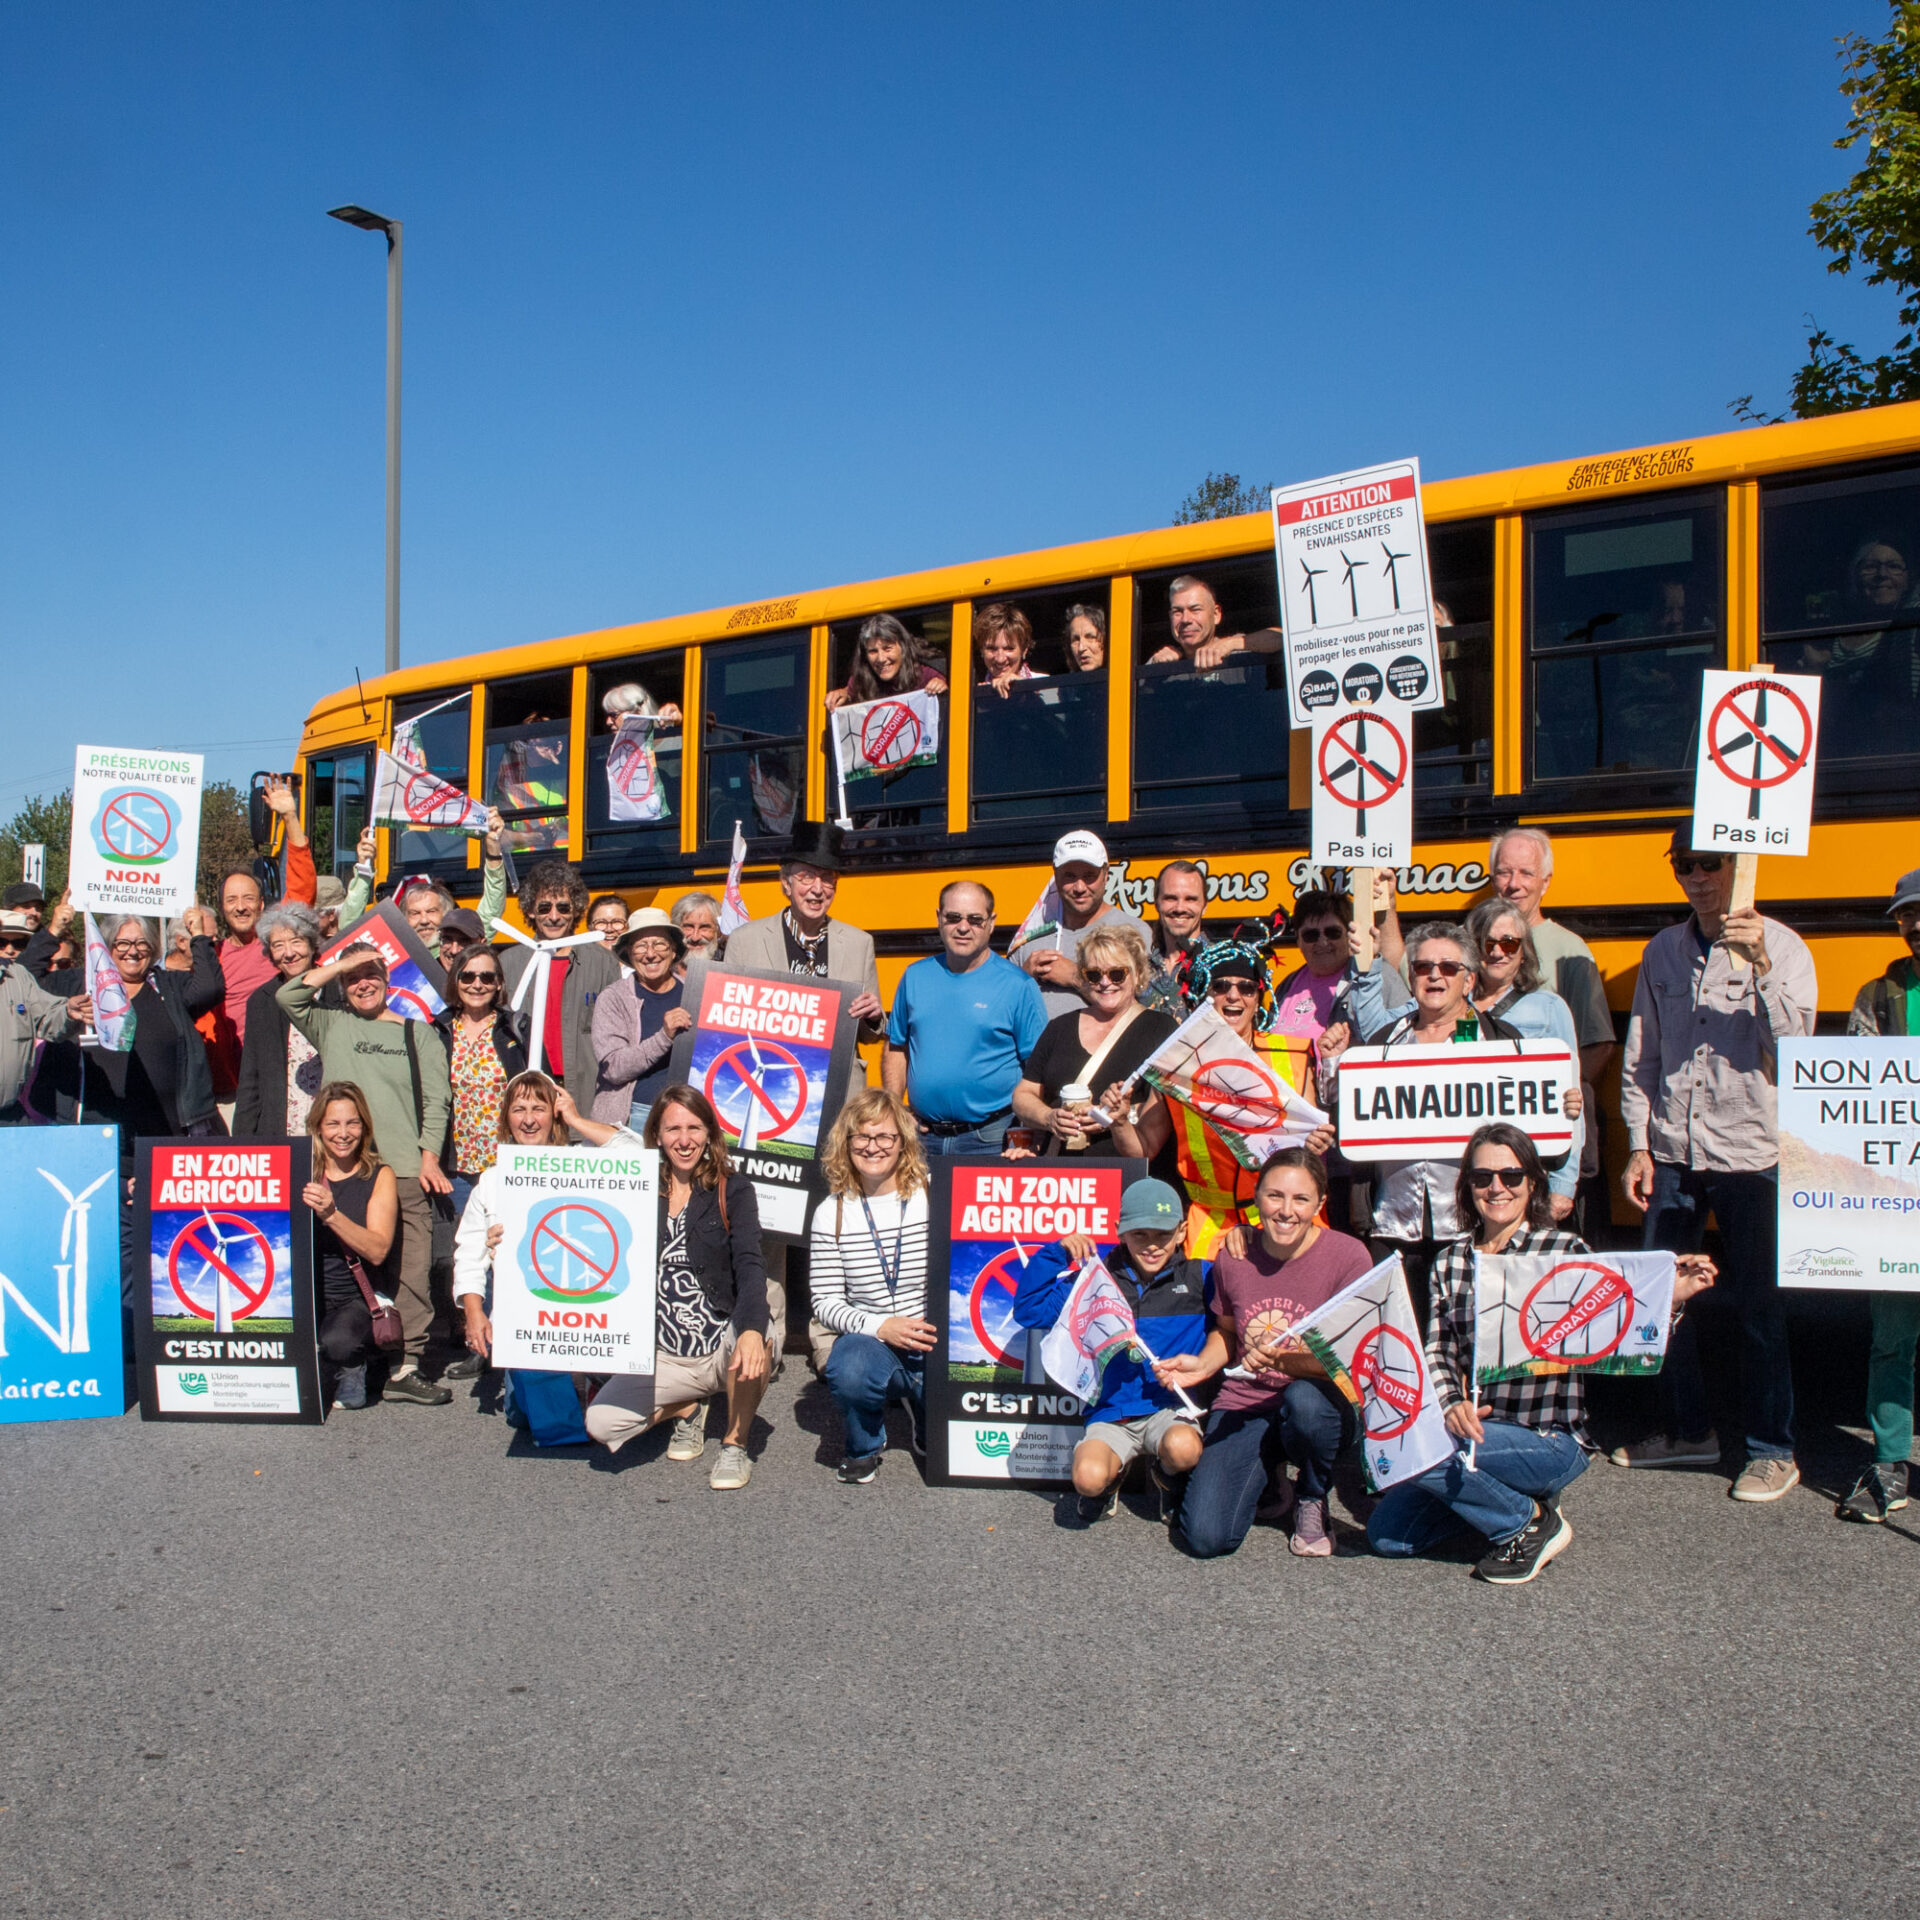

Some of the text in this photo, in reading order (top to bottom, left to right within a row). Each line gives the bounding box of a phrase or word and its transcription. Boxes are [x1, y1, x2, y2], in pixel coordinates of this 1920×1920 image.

[1574, 446, 1693, 476] EMERGENCY EXIT
[1567, 457, 1694, 490] SORTIE DE SECOURS
[1301, 483, 1392, 519] ATTENTION
[1292, 506, 1403, 539] PRÉSENCE D'ESPÈCES
[1307, 523, 1391, 551] ENVAHISSANTES
[1294, 623, 1425, 653] mobilisez-vous pour ne pas
[1299, 637, 1423, 668] propager les envahisseurs
[1313, 681, 1337, 692] BAPE
[1345, 674, 1379, 688] MORATOIRE
[870, 709, 906, 758] MORATOIRE
[90, 754, 190, 773] PRÉSERVONS
[82, 768, 197, 785] NOTRE QUALITÉ DE VIE
[414, 786, 457, 815] MORATOIR
[1713, 824, 1789, 844] Pas ici
[1328, 842, 1393, 858] Pas ici
[105, 869, 160, 885] NON
[1103, 858, 1269, 919] Aubus
[87, 883, 177, 897] EN MILIEU HABITÉ
[100, 893, 164, 905] ET AGRICOLE
[722, 981, 821, 1016] EN ZONE
[706, 1003, 827, 1042] AGRICOLE
[1795, 1059, 1920, 1084] NON AU
[1354, 1076, 1558, 1121] LANAUDIÈRE
[514, 1153, 641, 1175] PRÉSERVONS
[1863, 1141, 1901, 1165] ET
[172, 1153, 271, 1177] EN ZONE
[746, 1158, 802, 1183] NON!
[159, 1179, 281, 1203] AGRICOLE
[505, 1176, 650, 1191] NOTRE QUALITÉ DE VIE
[976, 1176, 1097, 1204] EN ZONE
[1792, 1191, 1834, 1209] OUI
[1840, 1196, 1864, 1210] au
[960, 1205, 1109, 1235] AGRICOLE
[1812, 1255, 1855, 1267] Vigilance
[1807, 1268, 1863, 1278] Brandonnie
[538, 1310, 608, 1329] NON
[1541, 1279, 1617, 1348] MORATOIRE
[515, 1329, 631, 1345] EN MILIEU HABITÉ
[165, 1340, 285, 1360] C'EST NON!
[531, 1343, 614, 1357] ET AGRICOLE
[0, 1371, 101, 1399] aire.ca
[178, 1372, 207, 1382] UPA
[211, 1372, 239, 1380] L'Union
[961, 1392, 1084, 1417] C'EST NO
[975, 1430, 1009, 1442] UPA
[1015, 1431, 1048, 1440] L'Union
[1015, 1452, 1058, 1462] Montérégie
